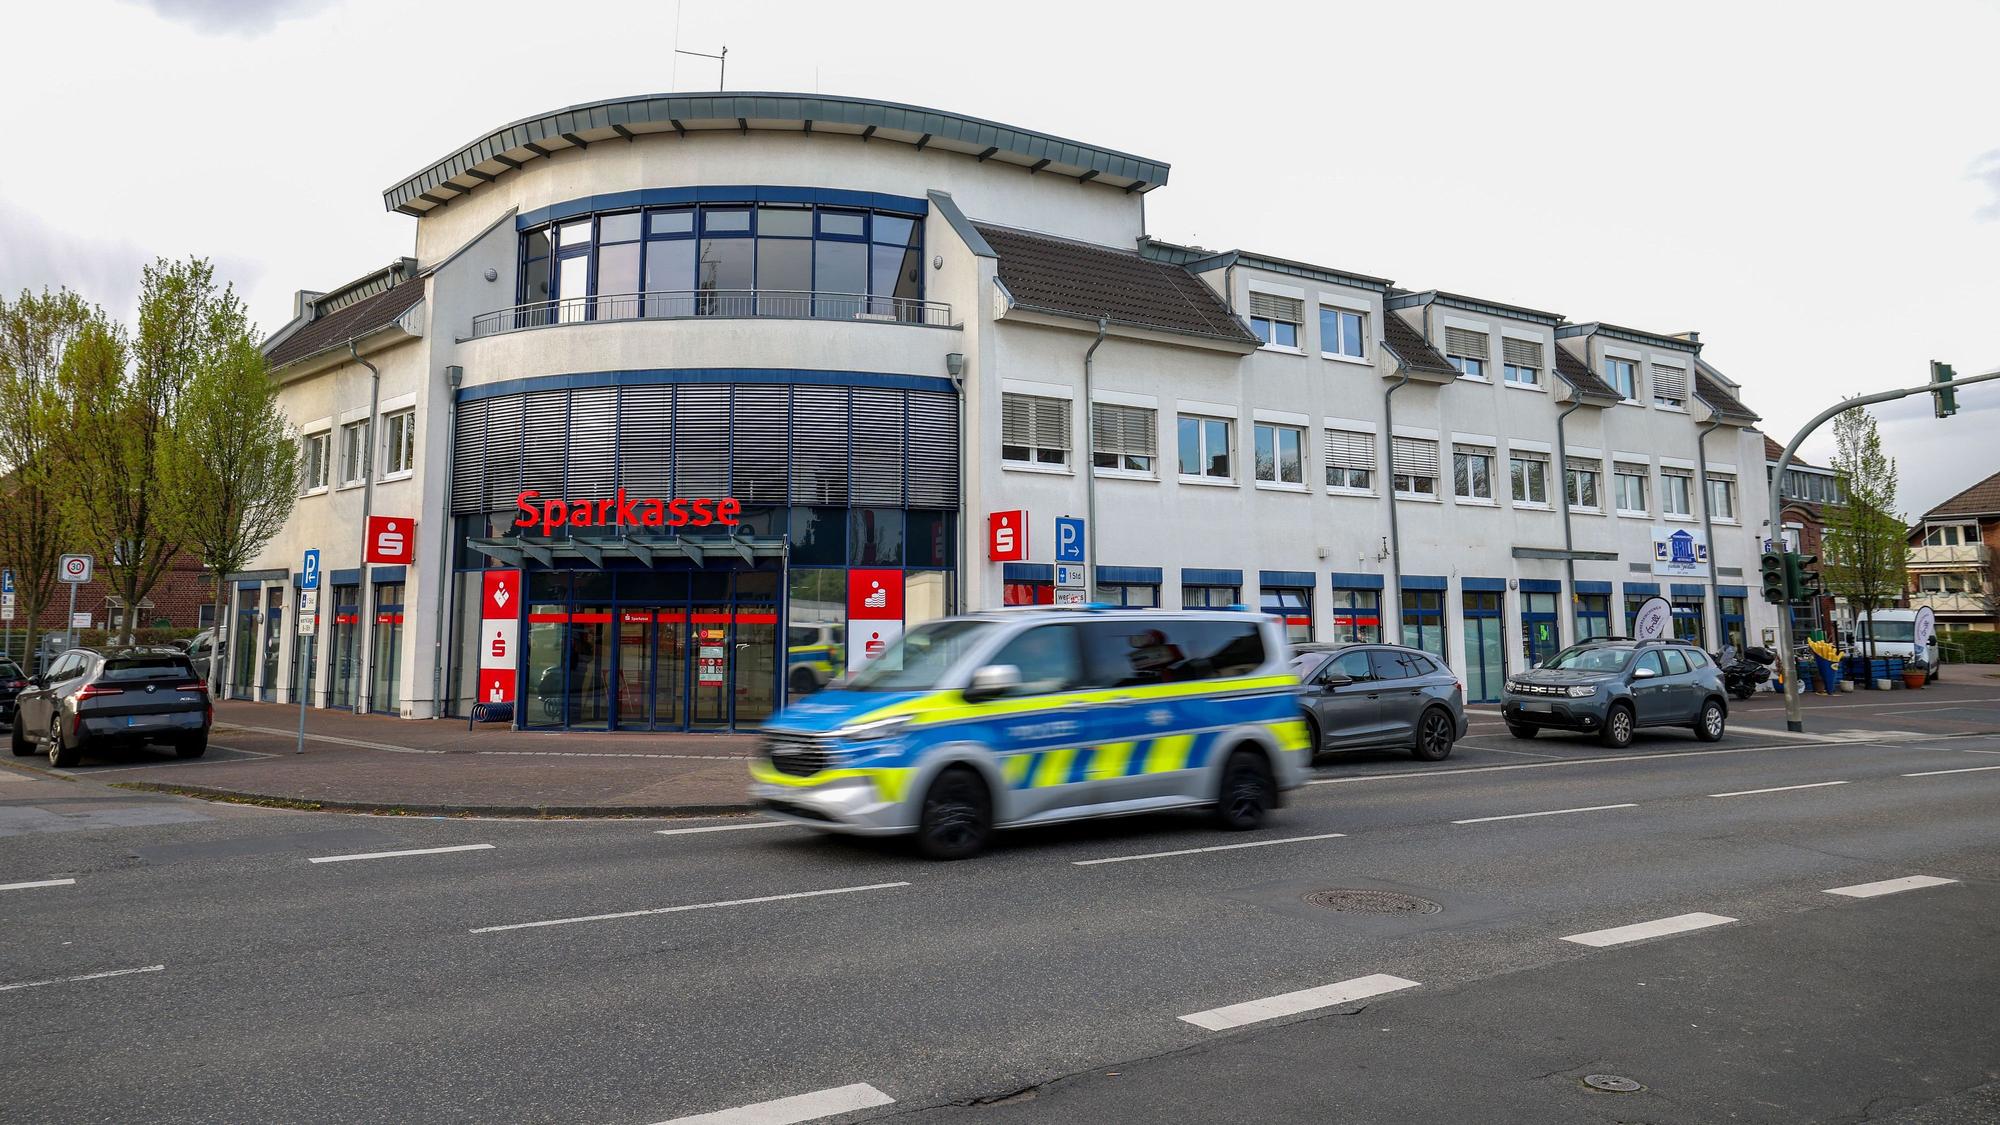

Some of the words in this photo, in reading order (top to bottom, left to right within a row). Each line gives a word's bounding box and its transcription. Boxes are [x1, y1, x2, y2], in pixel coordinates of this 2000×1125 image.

[515, 488, 741, 536] Sparkasse
[1060, 524, 1076, 556] P
[70, 562, 82, 571] 30
[305, 554, 316, 584] P
[1645, 614, 1661, 634] Grill
